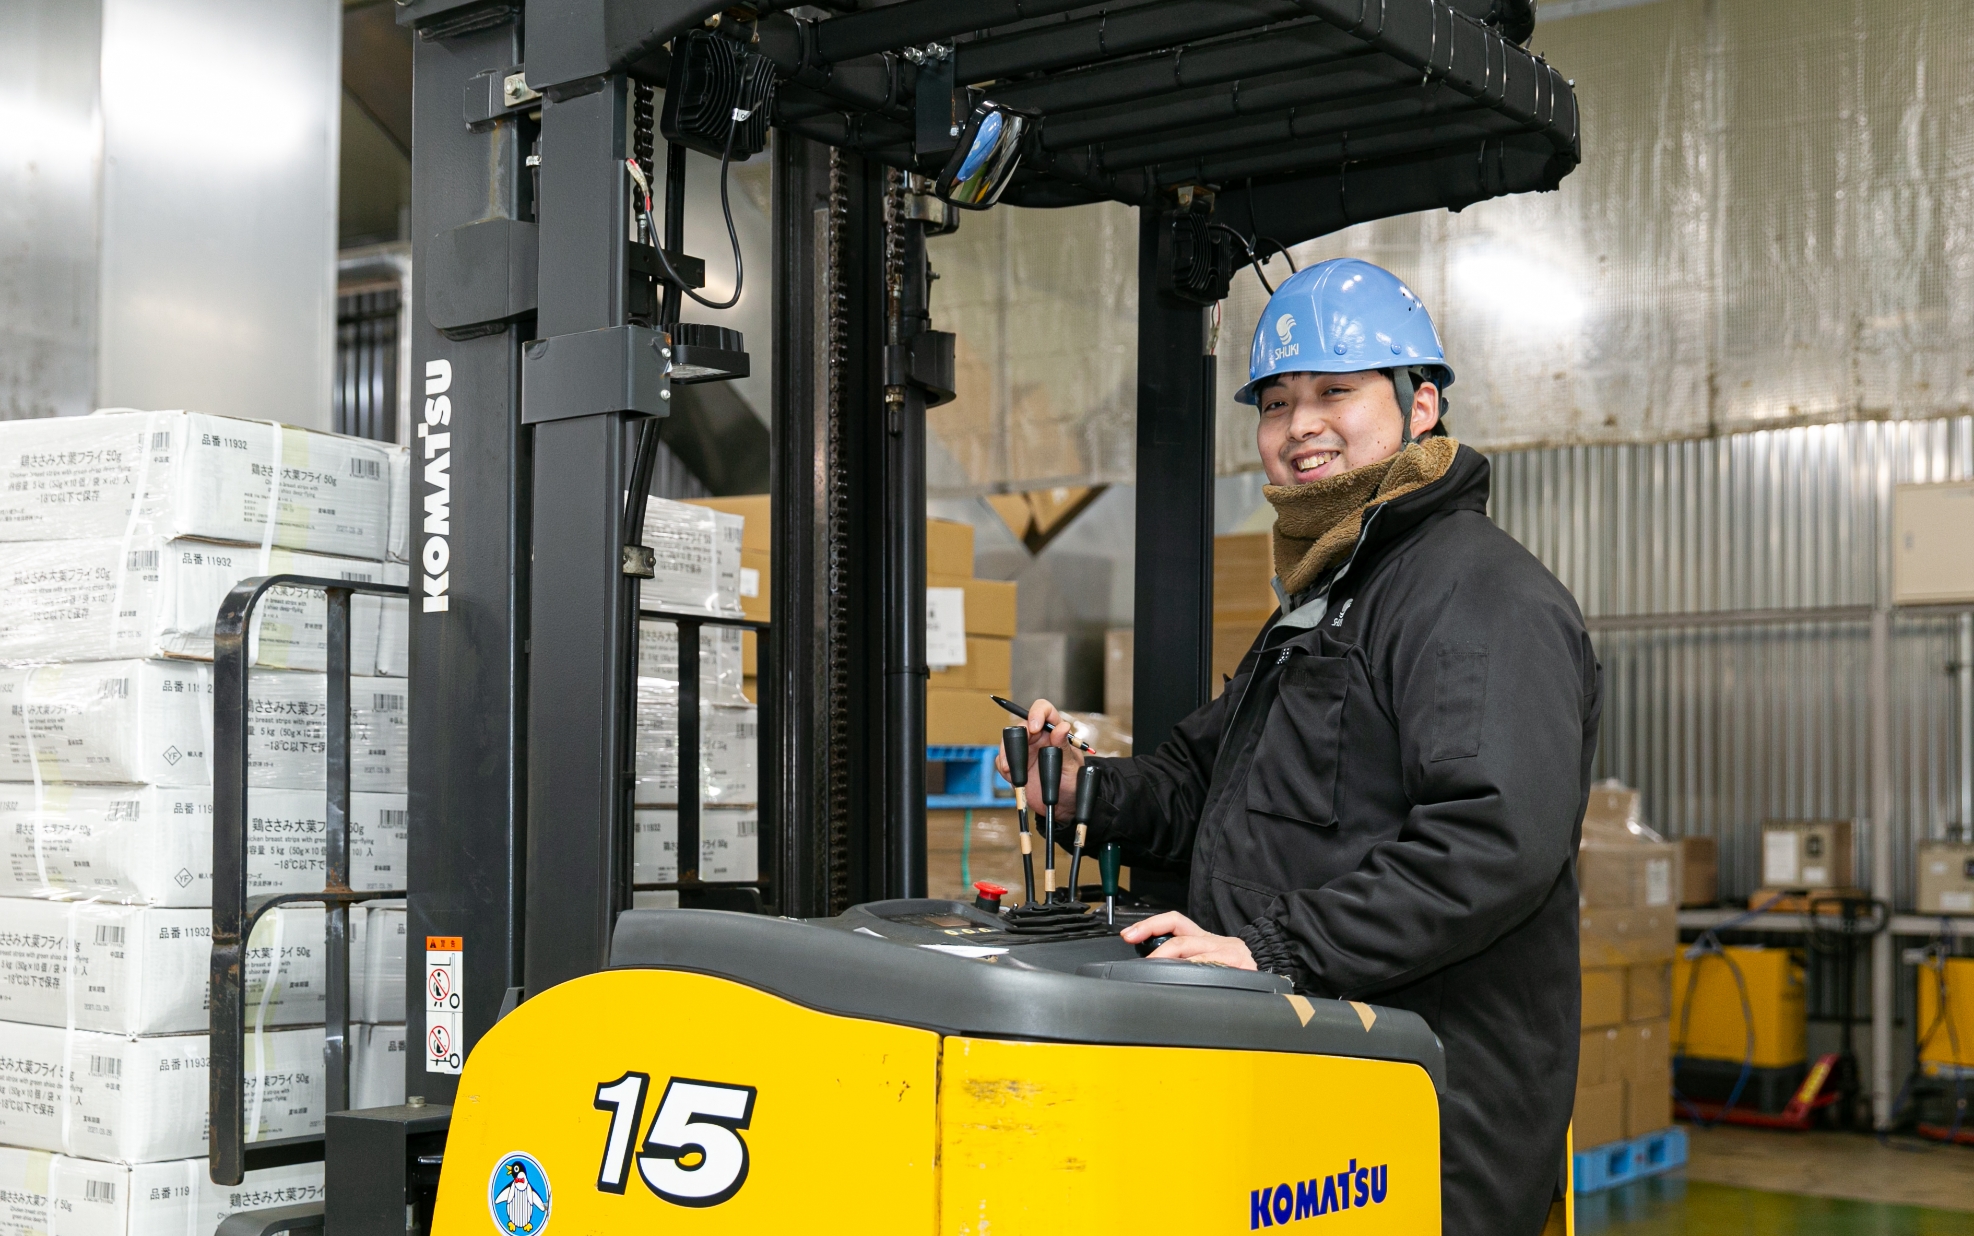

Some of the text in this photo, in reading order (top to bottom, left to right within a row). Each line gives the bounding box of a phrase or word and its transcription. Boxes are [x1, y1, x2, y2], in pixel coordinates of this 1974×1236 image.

[1275, 343, 1299, 360] SHUKI
[202, 433, 248, 450] 品番 11932
[106, 450, 122, 463] 50g
[252, 463, 321, 484] 鶏ささ大葉フライ
[324, 475, 337, 487] 50g
[418, 359, 452, 613] KOMATSU
[182, 552, 232, 568] 品番 11932
[95, 568, 111, 582] 50g
[163, 680, 184, 692] 品番
[168, 752, 178, 760] YF
[174, 802, 194, 814] 品番
[366, 847, 374, 857] 入
[179, 874, 190, 882] YF
[159, 926, 210, 939] 品番 11932
[296, 946, 311, 958] 50g
[81, 966, 88, 976] 入
[160, 1058, 210, 1072] 品番 11932
[296, 1073, 310, 1084] 50g
[76, 1096, 82, 1106] 入
[592, 1070, 758, 1209] 15
[150, 1187, 171, 1200] 品番
[230, 1185, 325, 1208] 鶏ささみ大葉フライ
[1250, 1158, 1388, 1231] KOMATSU
[60, 1199, 72, 1212] 50g
